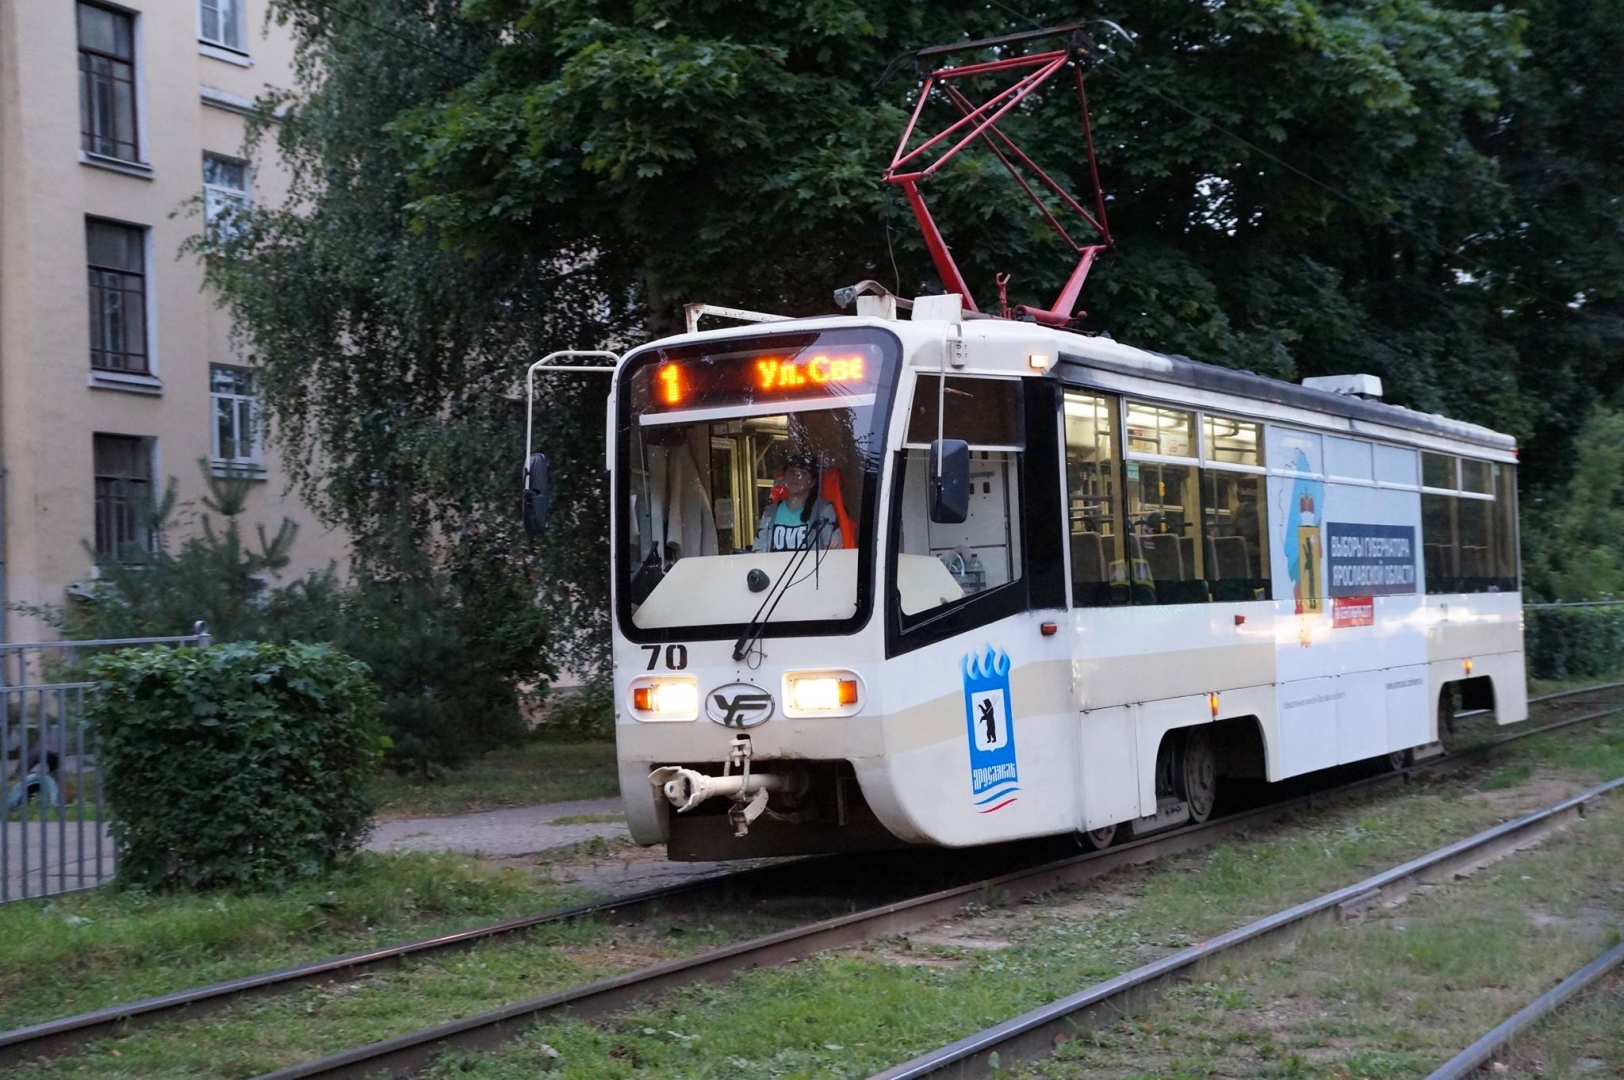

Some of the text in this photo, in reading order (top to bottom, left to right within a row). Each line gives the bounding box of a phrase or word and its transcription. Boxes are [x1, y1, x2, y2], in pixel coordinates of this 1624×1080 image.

[660, 364, 679, 403] 1
[773, 525, 807, 550] OVE
[641, 644, 688, 671] 70
